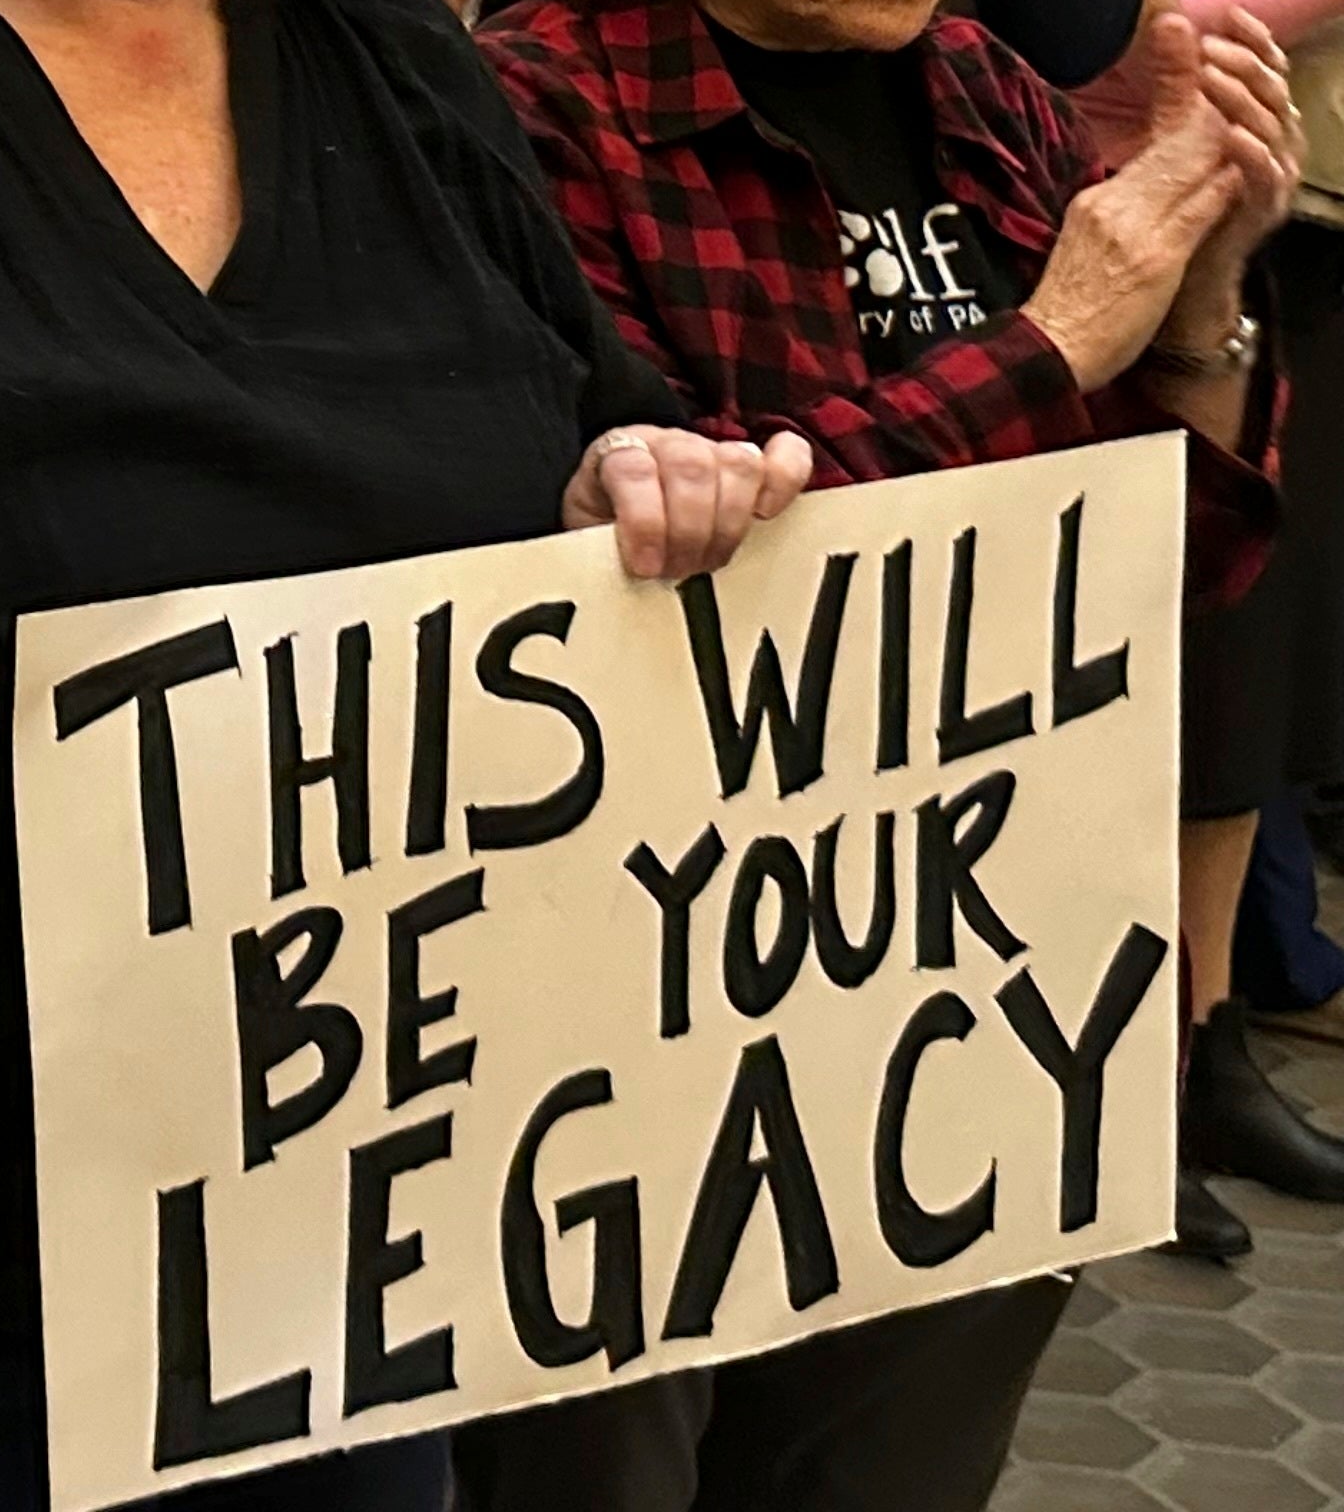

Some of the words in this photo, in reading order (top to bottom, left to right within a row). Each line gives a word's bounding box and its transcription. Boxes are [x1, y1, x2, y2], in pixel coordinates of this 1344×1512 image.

[909, 304, 936, 335] of
[53, 598, 605, 936] THIS
[674, 493, 1130, 800] WILL
[229, 866, 489, 1172] BE
[623, 768, 1027, 1039] YOUR
[151, 922, 1168, 1471] LEGACY
